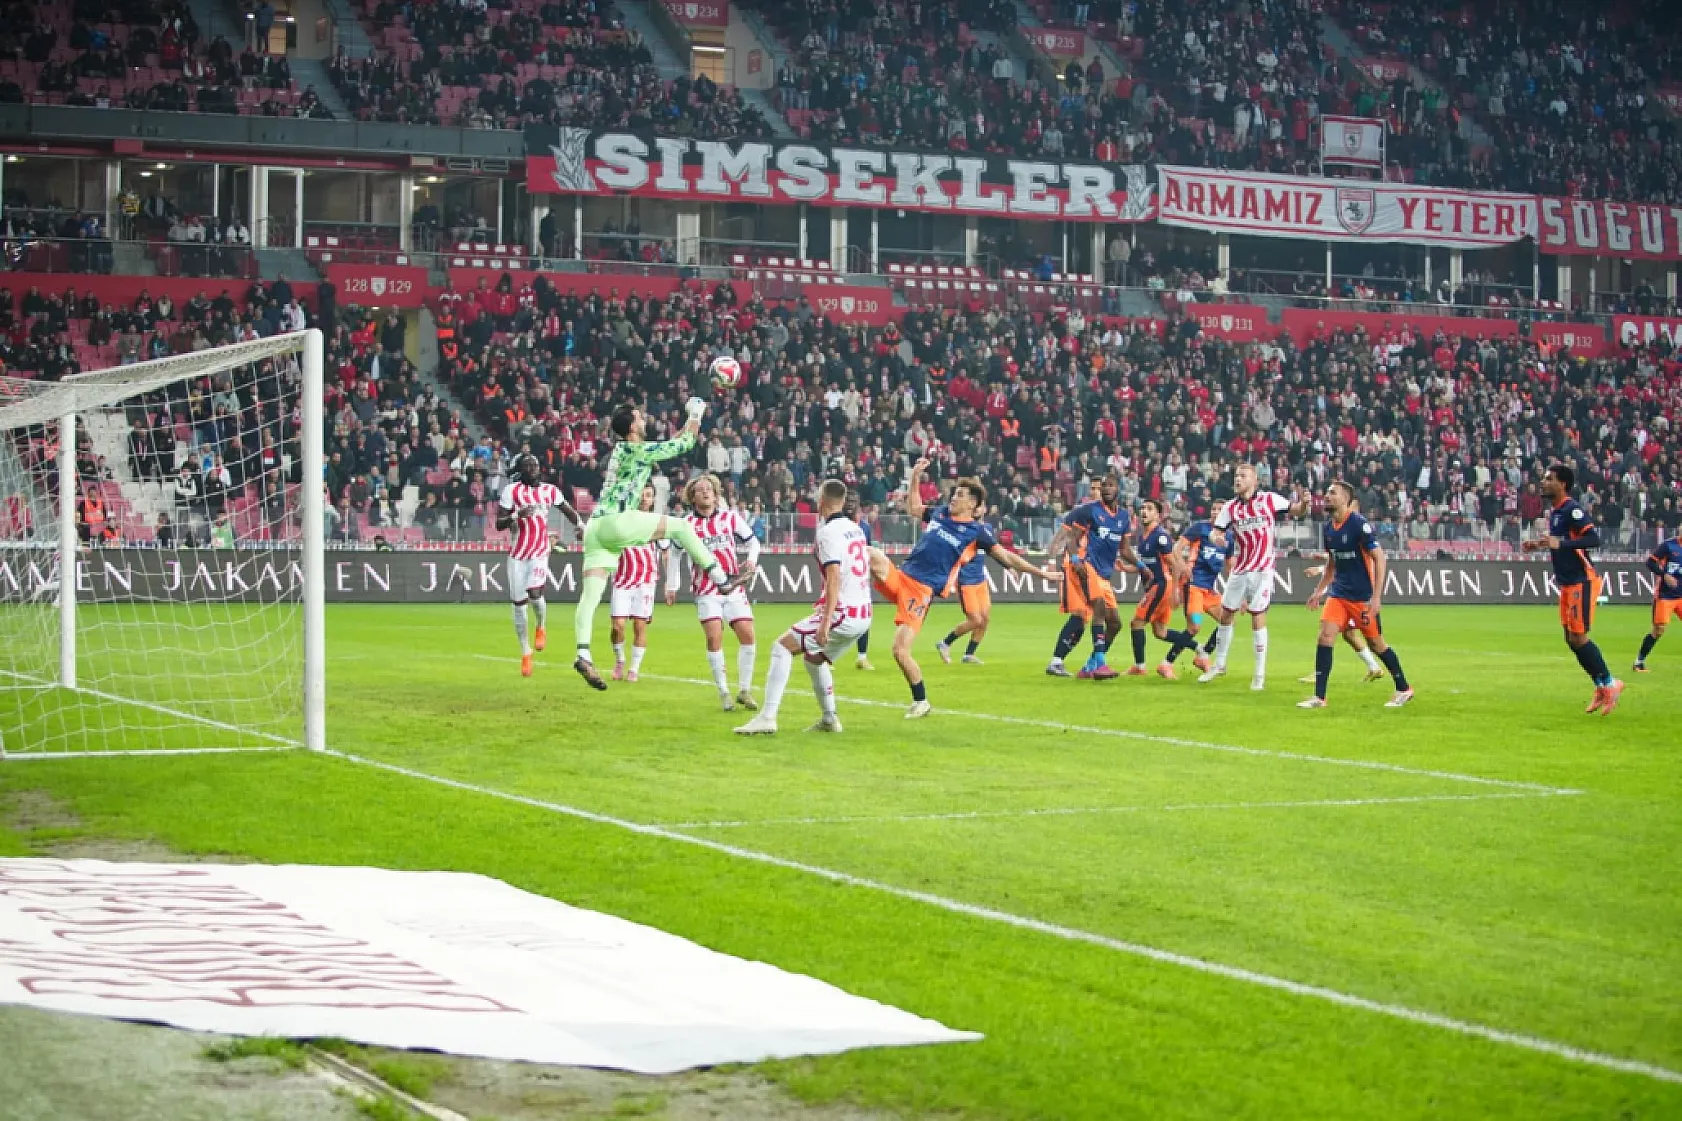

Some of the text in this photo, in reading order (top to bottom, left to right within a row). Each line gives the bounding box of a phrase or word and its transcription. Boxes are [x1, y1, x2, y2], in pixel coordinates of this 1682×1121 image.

[1163, 176, 1528, 236] ARMAMIZ YETER!
[345, 278, 412, 293] 128 129
[857, 300, 878, 313] 130
[1200, 316, 1254, 331] 130 131
[1360, 611, 1370, 626] 5
